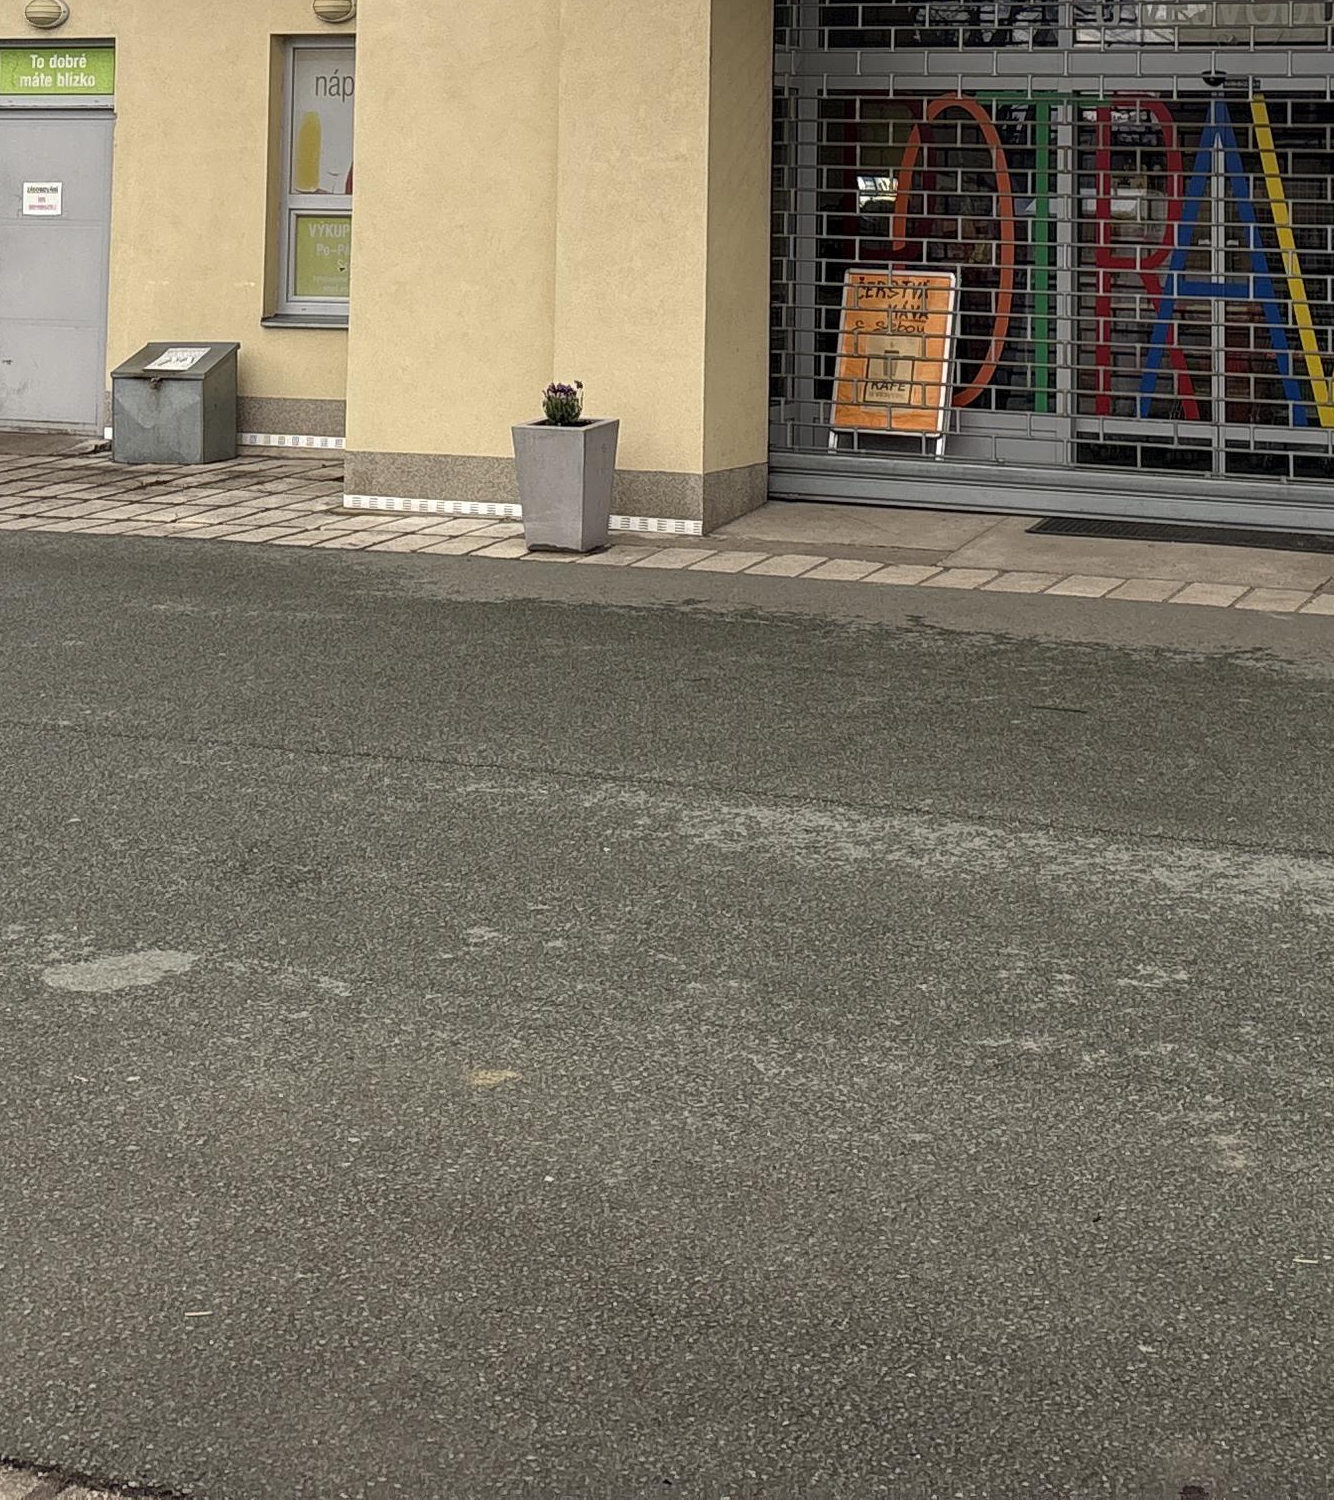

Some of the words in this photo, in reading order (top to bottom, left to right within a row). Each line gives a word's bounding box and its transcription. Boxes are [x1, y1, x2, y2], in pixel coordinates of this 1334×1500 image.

[30, 54, 45, 69] To
[49, 53, 87, 69] dobré
[20, 72, 53, 88] máte
[57, 71, 96, 88] blízko
